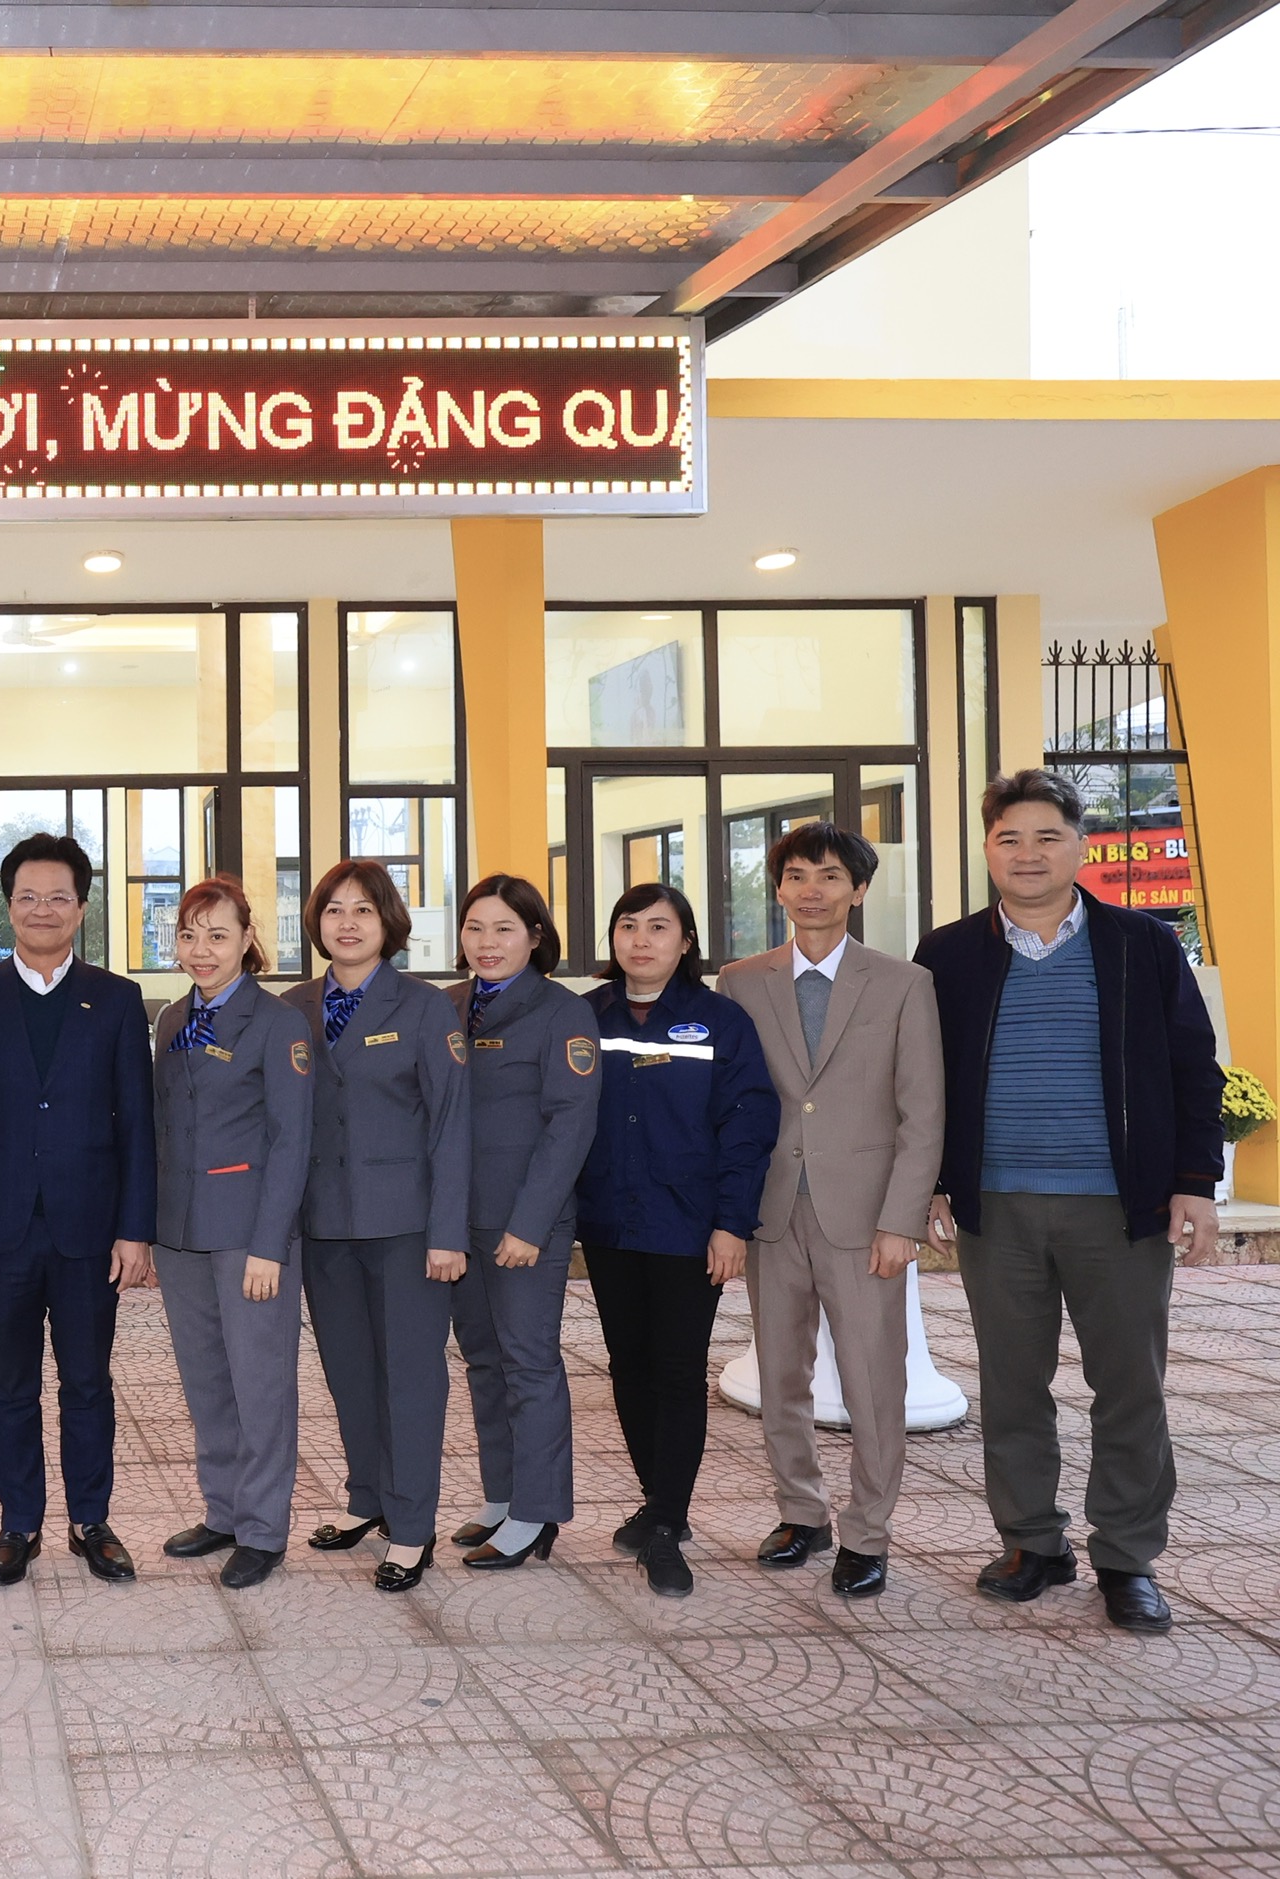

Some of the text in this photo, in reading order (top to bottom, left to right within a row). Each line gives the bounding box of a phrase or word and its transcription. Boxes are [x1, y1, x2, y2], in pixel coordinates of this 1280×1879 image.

[82, 377, 313, 452] MỪNG
[333, 376, 542, 450] ĐẢNG
[1150, 885, 1179, 905] SẢN
